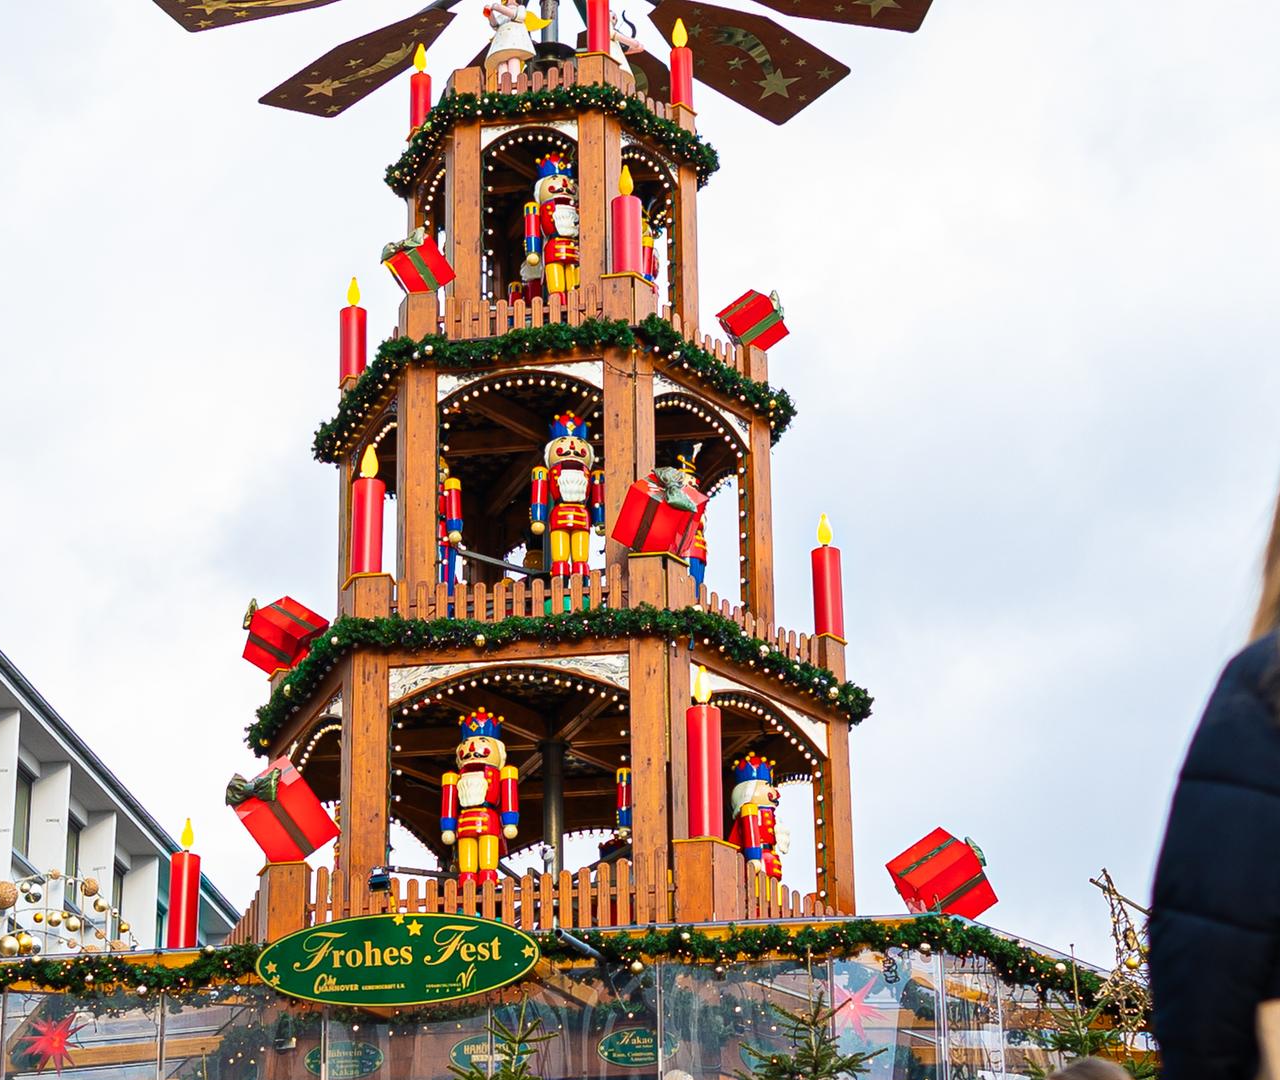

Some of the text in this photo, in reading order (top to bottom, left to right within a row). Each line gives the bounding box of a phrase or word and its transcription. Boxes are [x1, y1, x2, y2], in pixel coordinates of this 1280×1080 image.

[292, 924, 502, 973] Frohes Fest
[616, 1031, 653, 1046] Kakao
